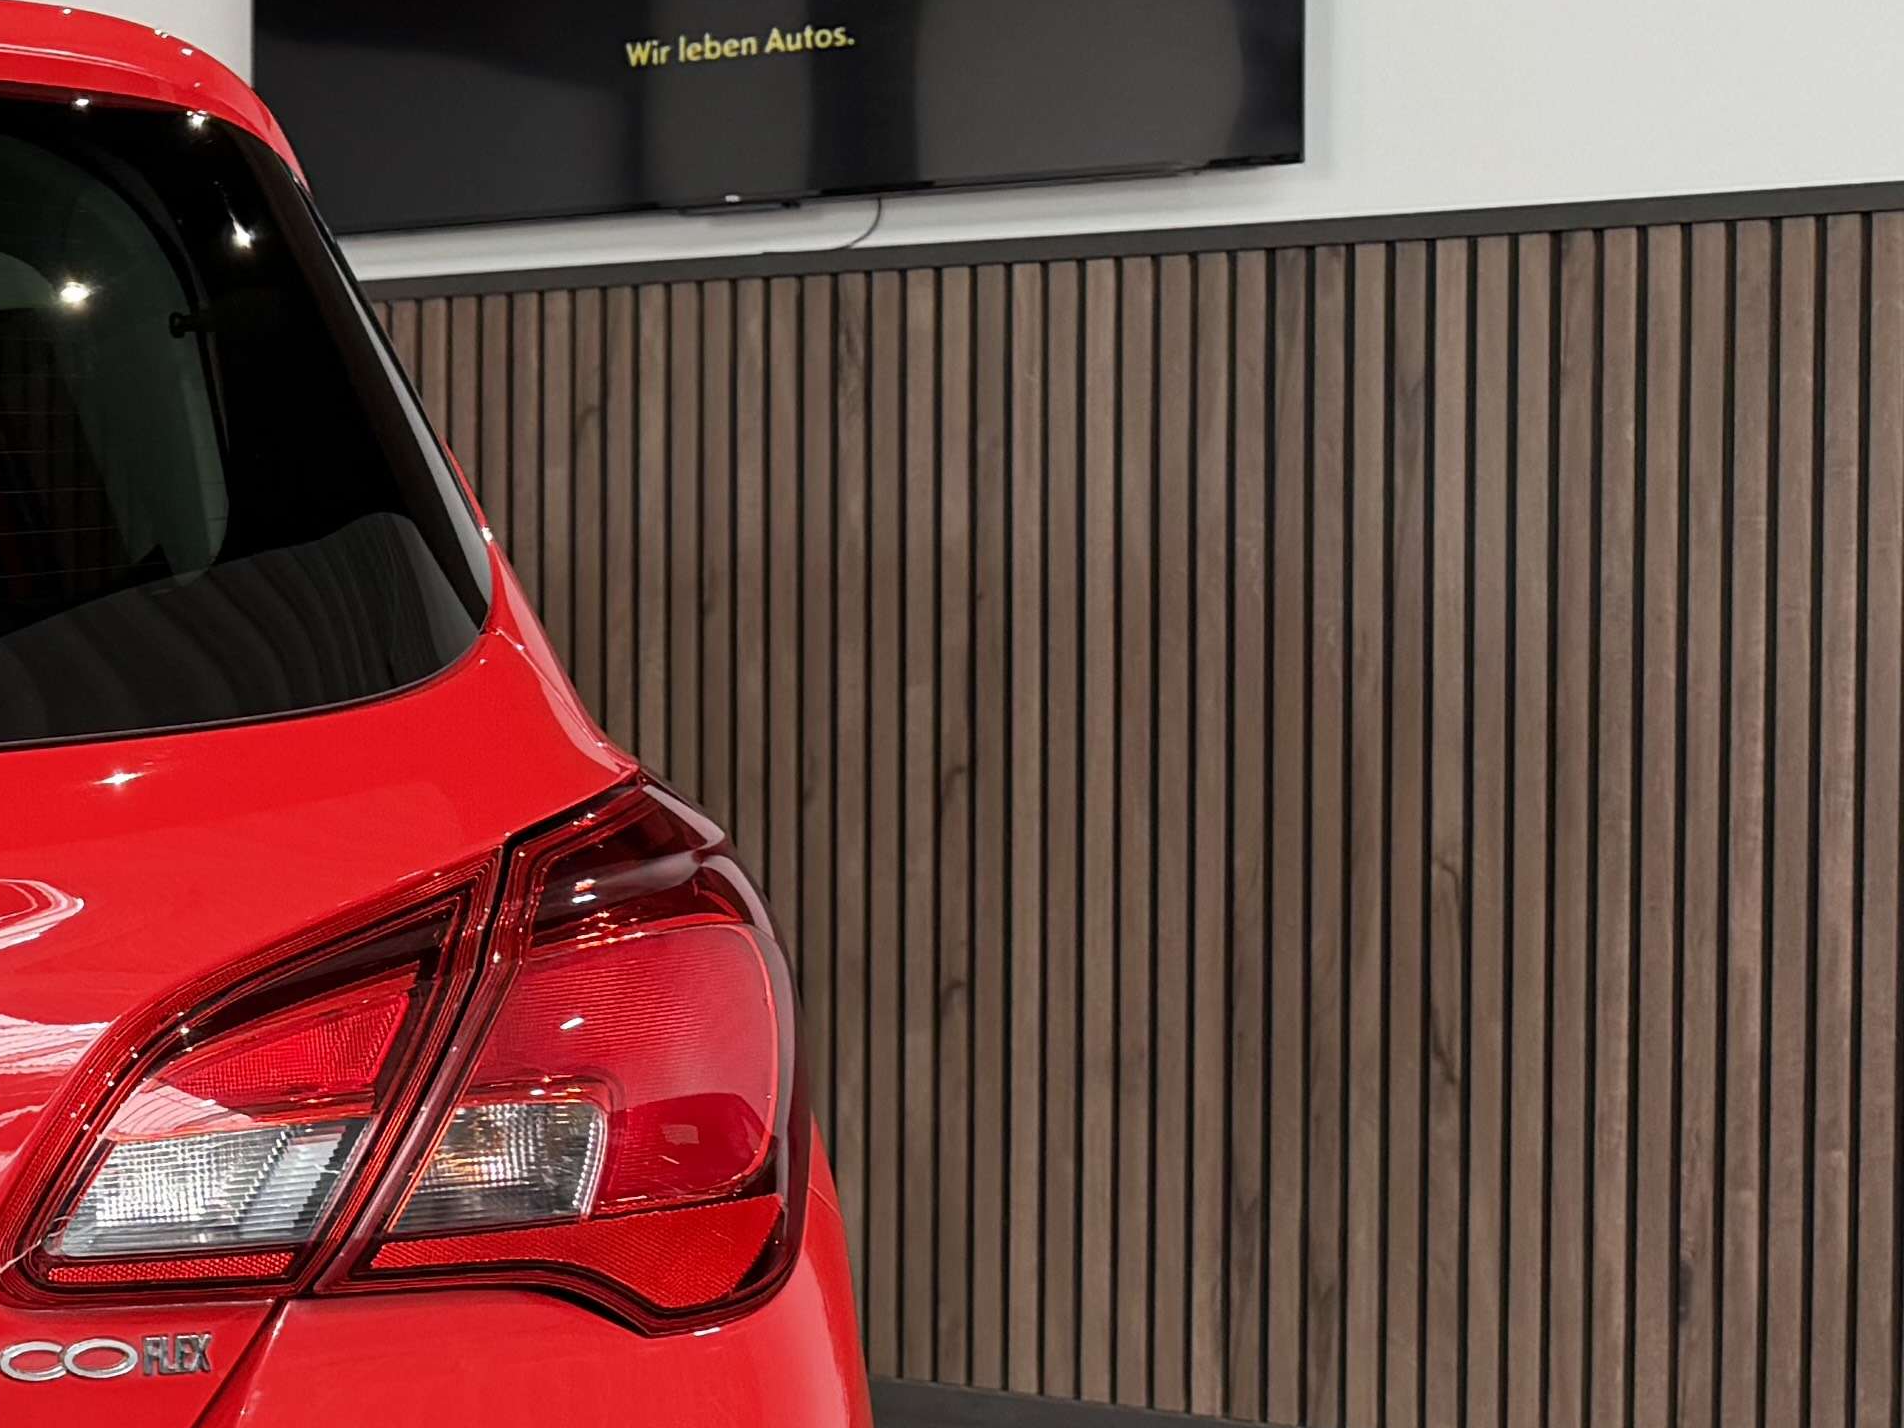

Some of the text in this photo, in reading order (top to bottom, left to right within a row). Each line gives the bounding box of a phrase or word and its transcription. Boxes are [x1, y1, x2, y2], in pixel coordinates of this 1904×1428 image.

[626, 24, 856, 68] Wir leben Autos.
